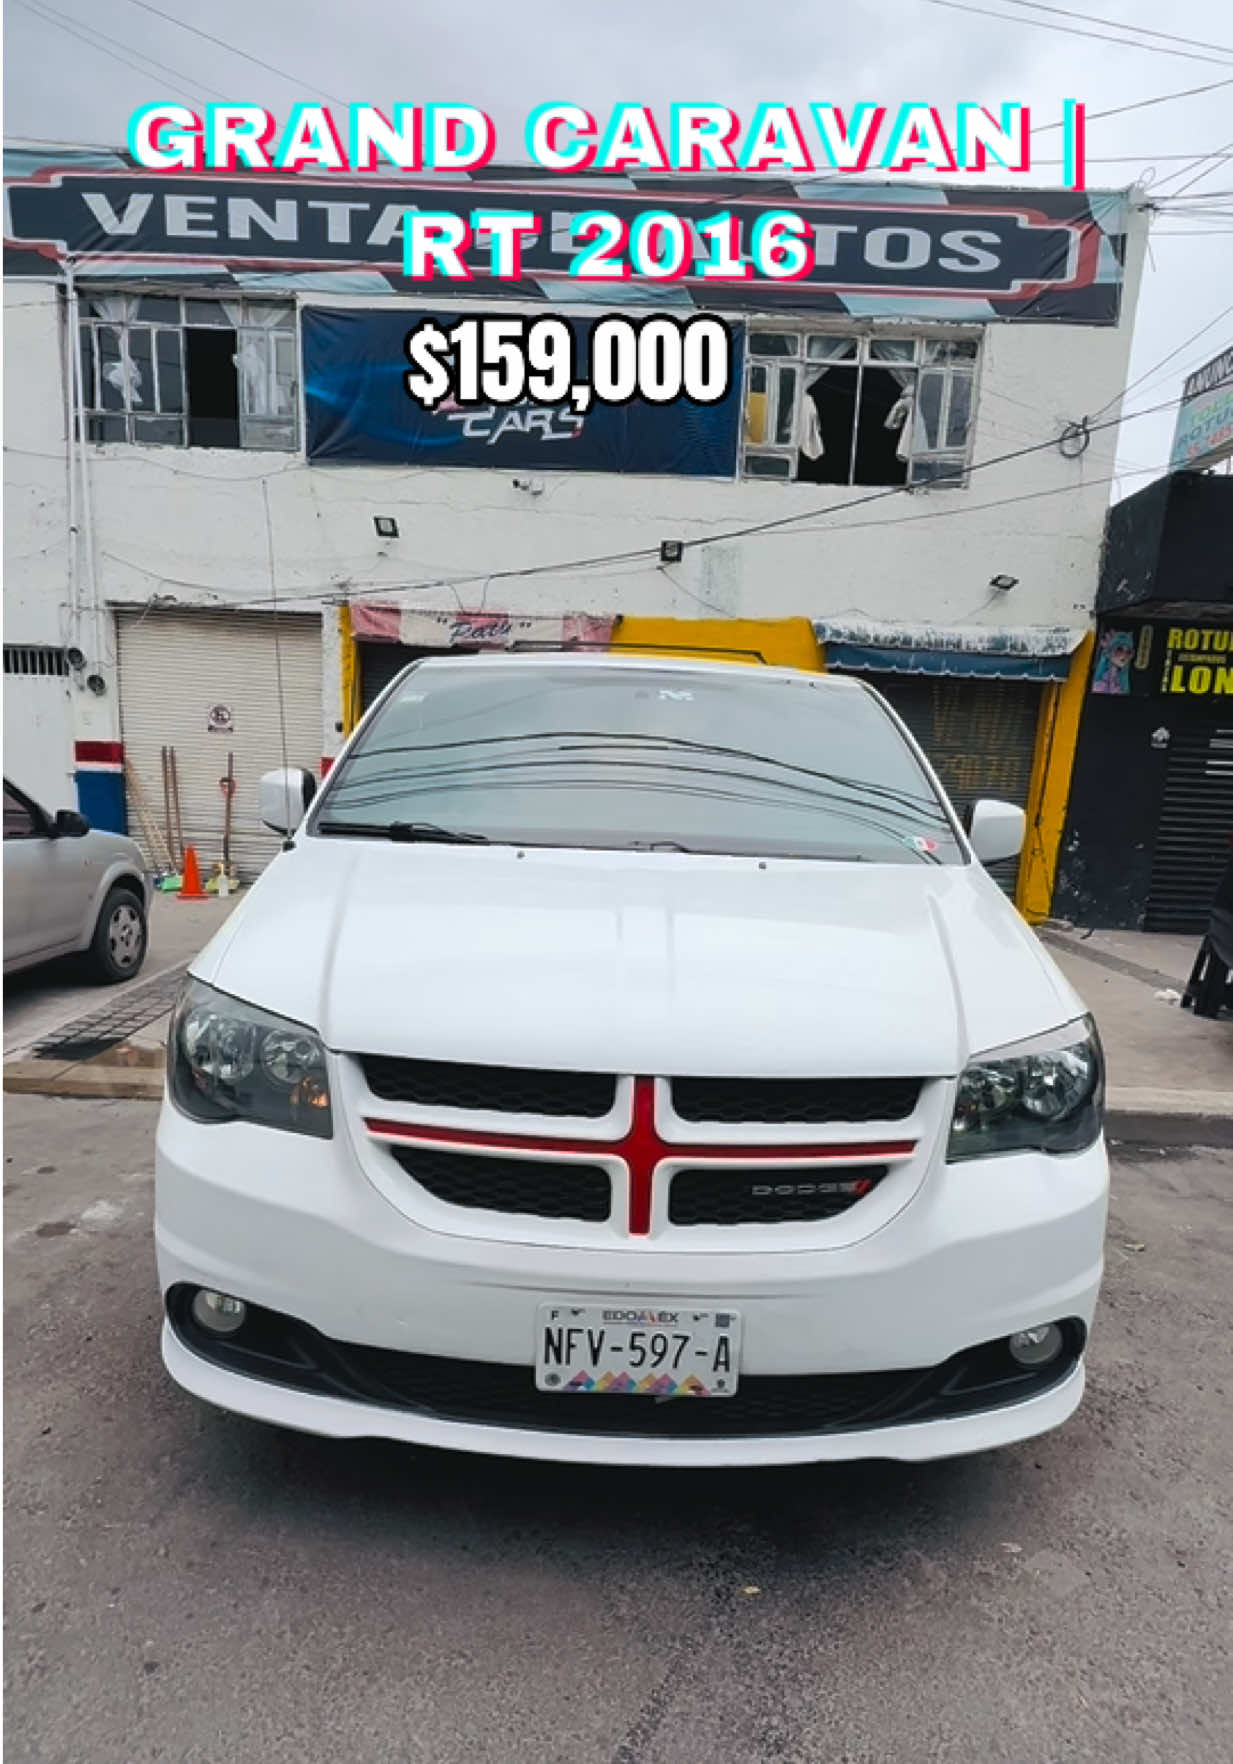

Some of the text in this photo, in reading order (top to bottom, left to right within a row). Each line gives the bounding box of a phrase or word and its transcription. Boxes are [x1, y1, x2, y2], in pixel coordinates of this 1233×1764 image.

[447, 405, 584, 445] CARS
[1167, 628, 1233, 651] ROTU
[544, 1326, 731, 1373] NFV-597-A
